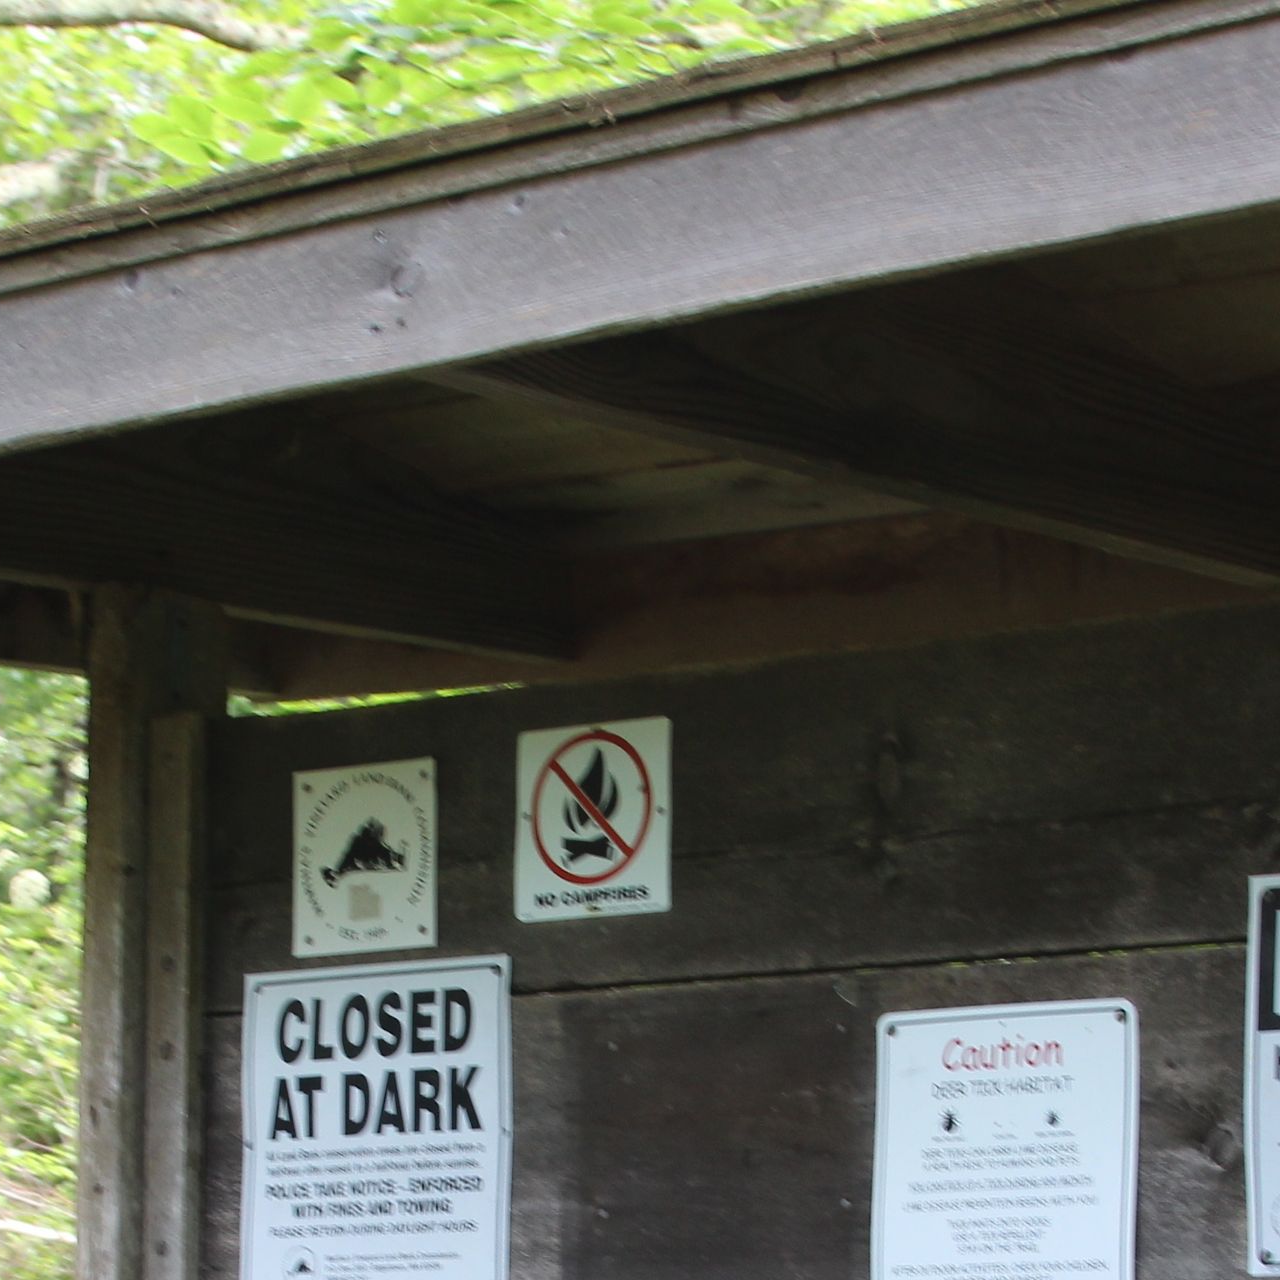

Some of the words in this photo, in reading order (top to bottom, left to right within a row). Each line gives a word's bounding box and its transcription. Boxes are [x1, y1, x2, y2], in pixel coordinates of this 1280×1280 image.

[533, 890, 557, 909] NO
[560, 884, 651, 907] CAMPFIRES
[278, 987, 471, 1064] CLOSED
[941, 1034, 1064, 1072] Caution
[270, 1075, 325, 1141] AT
[343, 1064, 483, 1136] DARK
